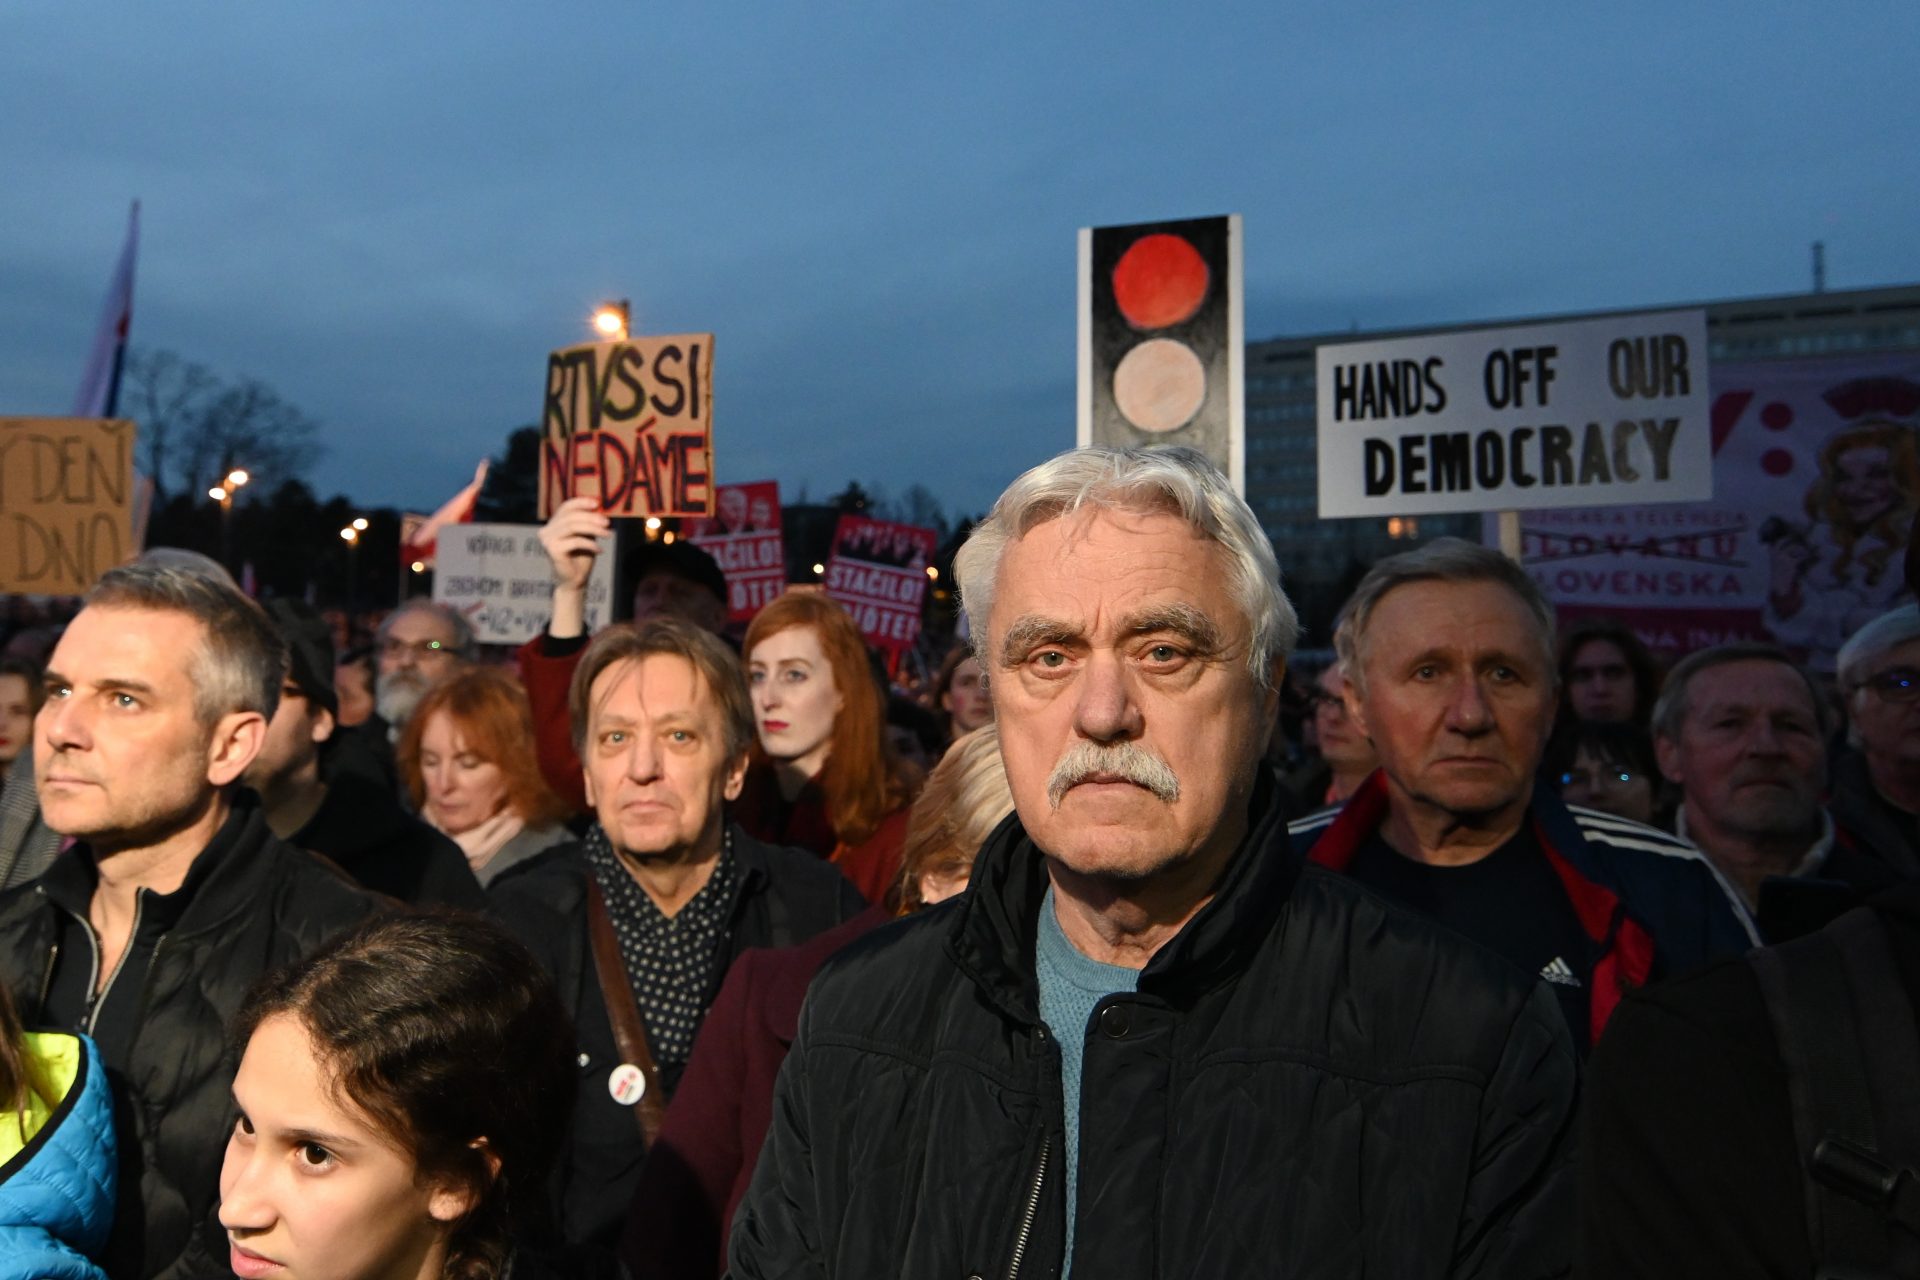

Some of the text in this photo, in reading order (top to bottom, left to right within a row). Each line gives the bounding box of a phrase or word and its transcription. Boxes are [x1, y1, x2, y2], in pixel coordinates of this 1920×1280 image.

[546, 343, 701, 438] RTVS SI
[1334, 334, 1691, 422] HANDS OFF OUR
[1363, 418, 1681, 497] DEMOCRACY
